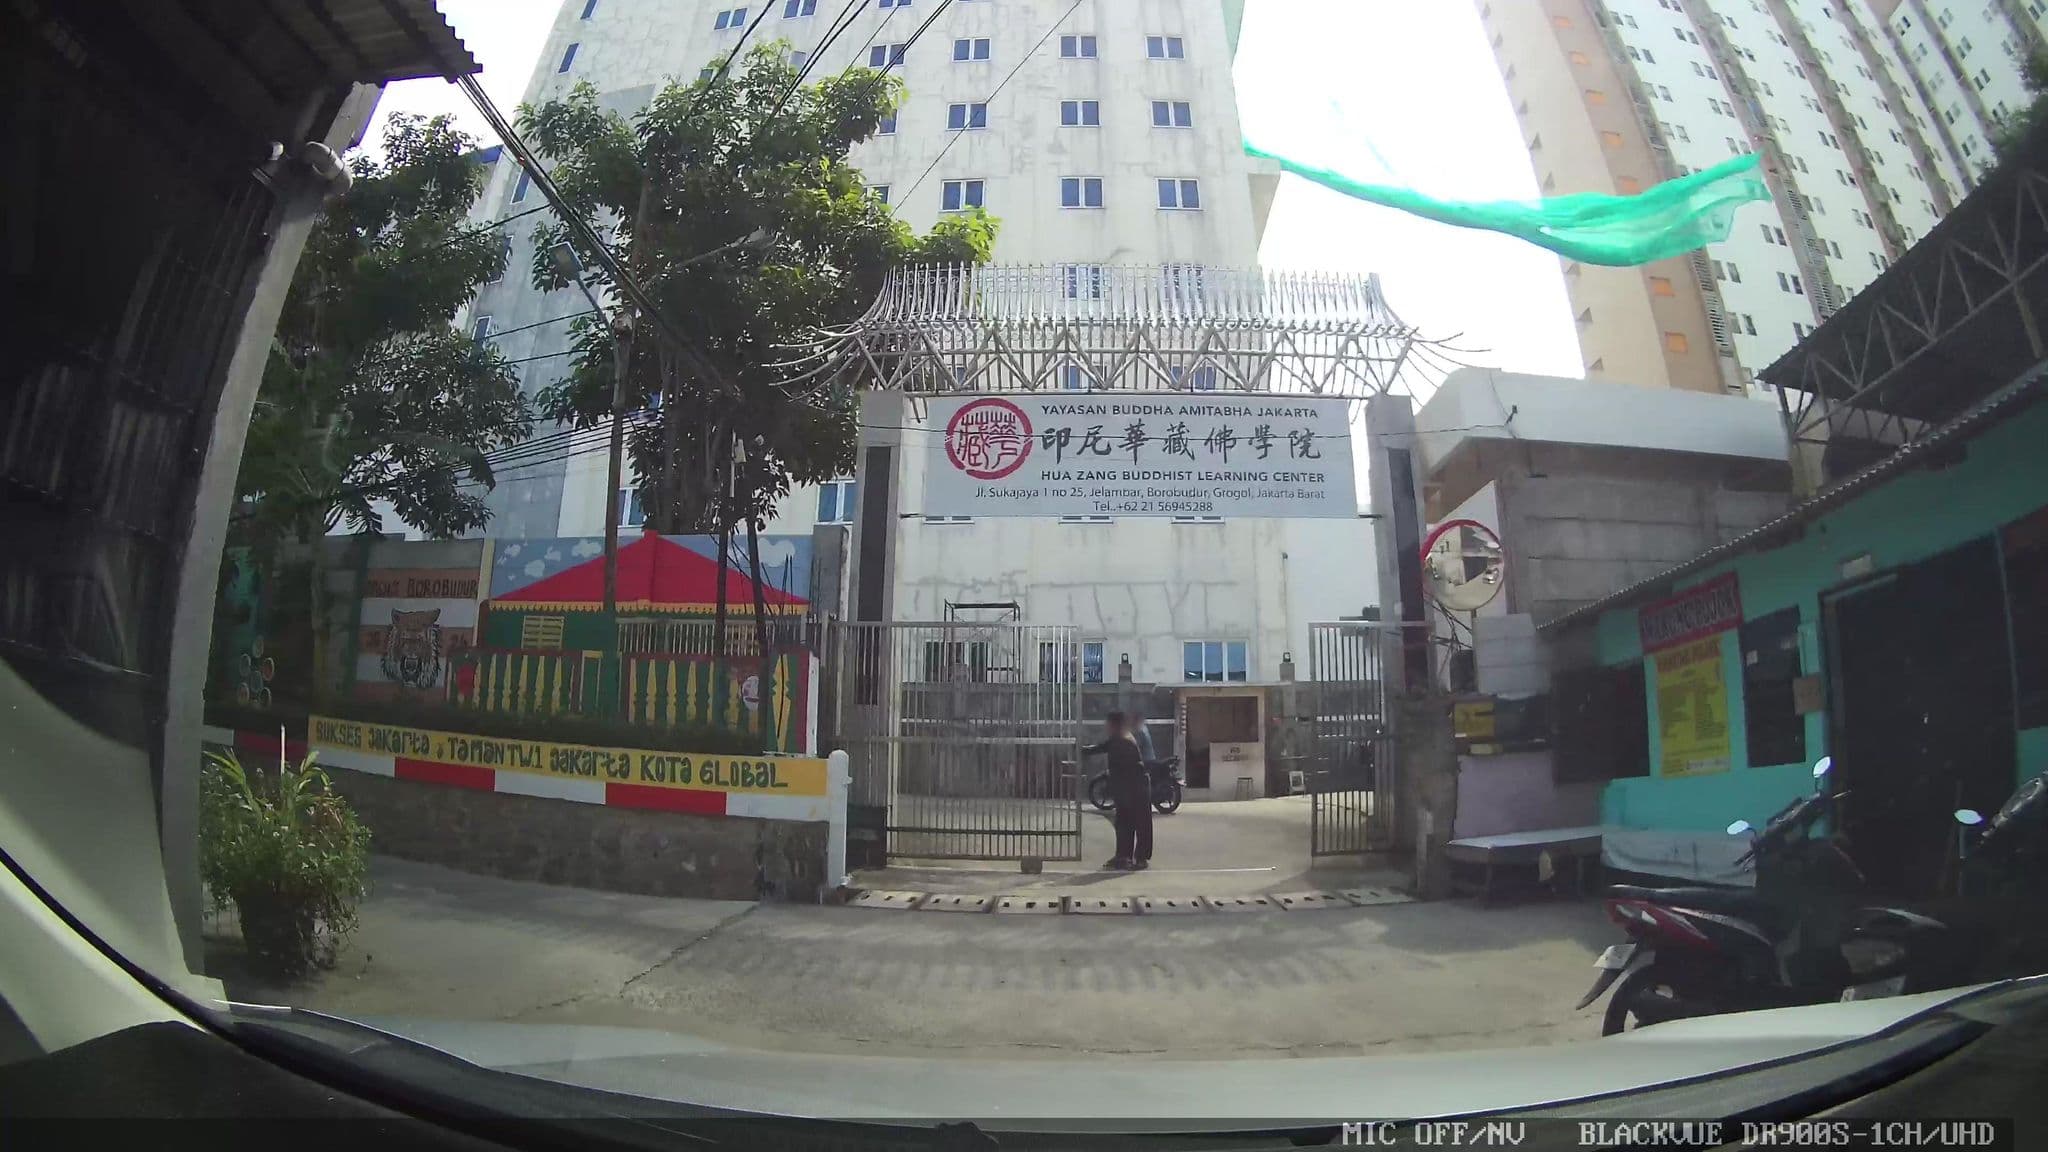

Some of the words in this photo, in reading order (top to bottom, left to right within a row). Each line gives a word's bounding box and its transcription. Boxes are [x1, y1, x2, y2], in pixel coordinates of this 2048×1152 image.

[1041, 405, 1107, 415] YAYASAN
[1112, 405, 1174, 416] BUDDHA
[1178, 405, 1251, 417] AMITABHA
[1257, 407, 1318, 418] JAKARTA
[1041, 418, 1322, 465] 印尼華藏佛學院
[1041, 471, 1072, 481] HUA
[1076, 471, 1117, 481] ZANG
[1122, 471, 1193, 482] BUDDHIST
[1197, 471, 1268, 482] LEARNING
[1272, 472, 1325, 483] CENTER
[989, 487, 1039, 499] Sukajaya
[1052, 489, 1067, 497] no
[1070, 487, 1087, 498] 25,
[1089, 487, 1144, 499] Jelambar,
[1256, 488, 1295, 499] Jakarta
[1297, 489, 1326, 499] Barat
[1141, 501, 1154, 511] 21
[1158, 501, 1213, 512] 56945288
